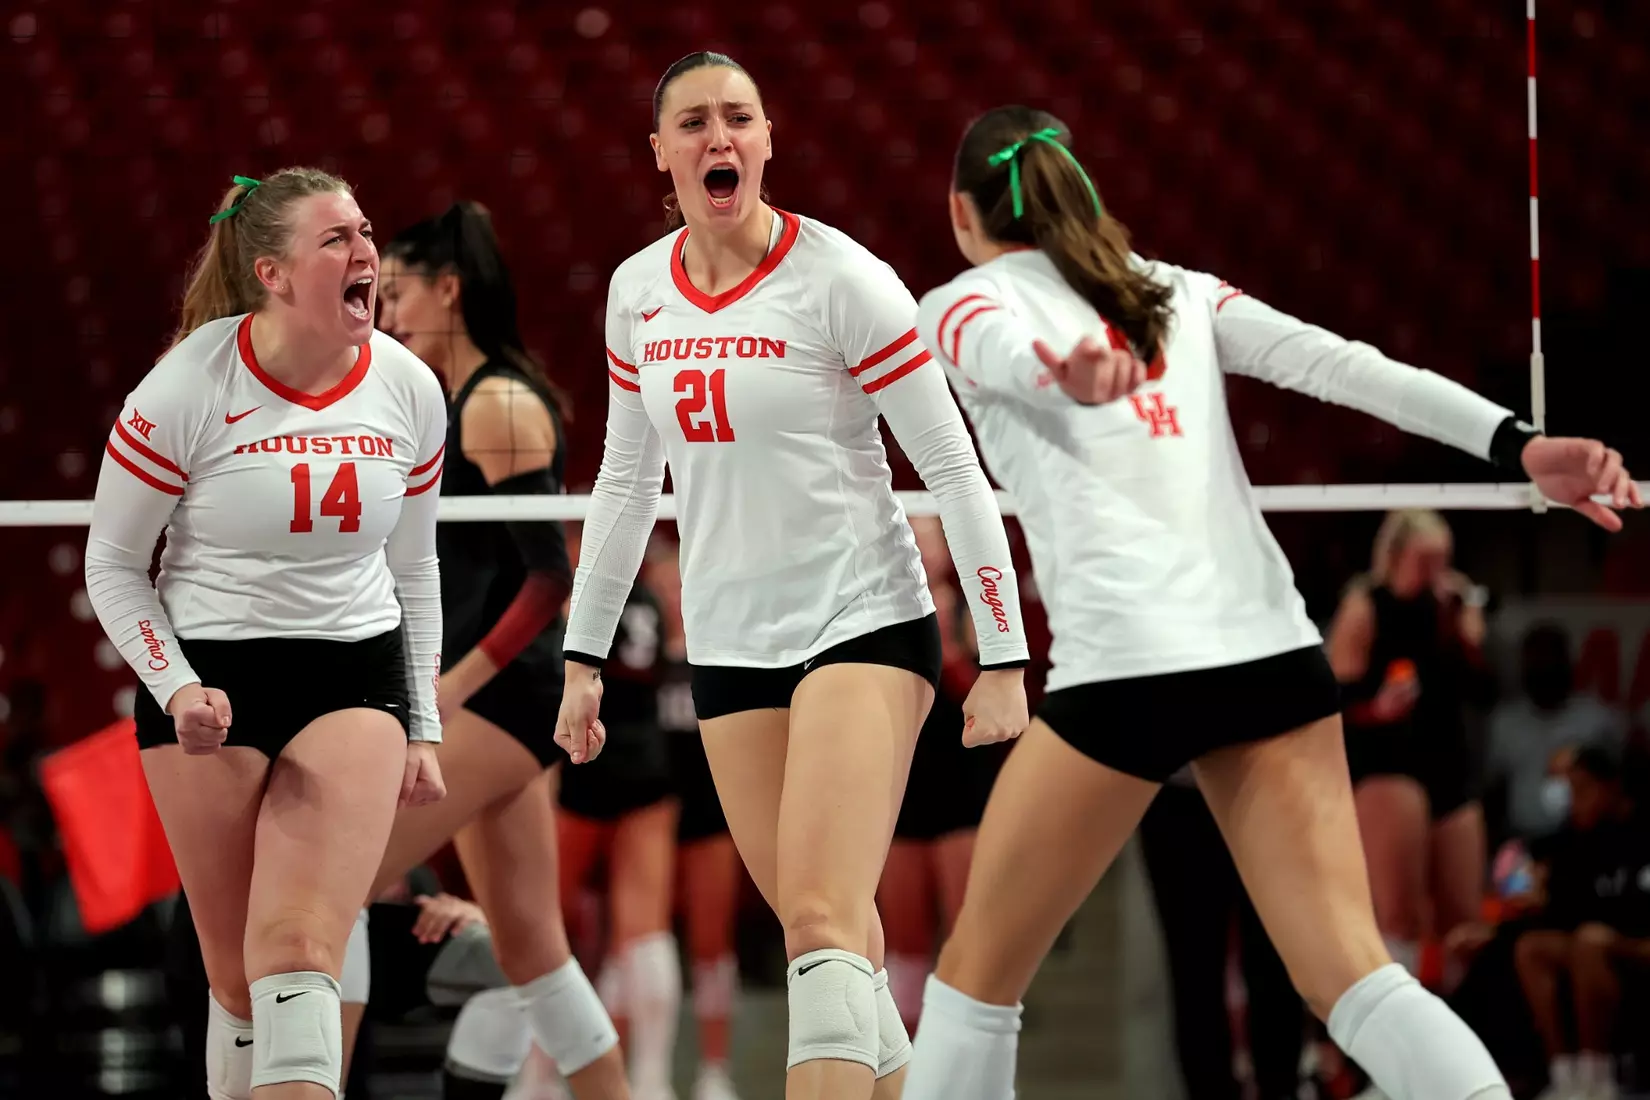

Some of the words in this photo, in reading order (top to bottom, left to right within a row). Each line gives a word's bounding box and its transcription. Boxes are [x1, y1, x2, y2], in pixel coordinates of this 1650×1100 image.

[643, 336, 787, 362] HOUSTON
[673, 368, 736, 442] 21
[289, 462, 362, 533] 14
[977, 566, 1010, 633] Cougars
[138, 619, 169, 671] Cougars
